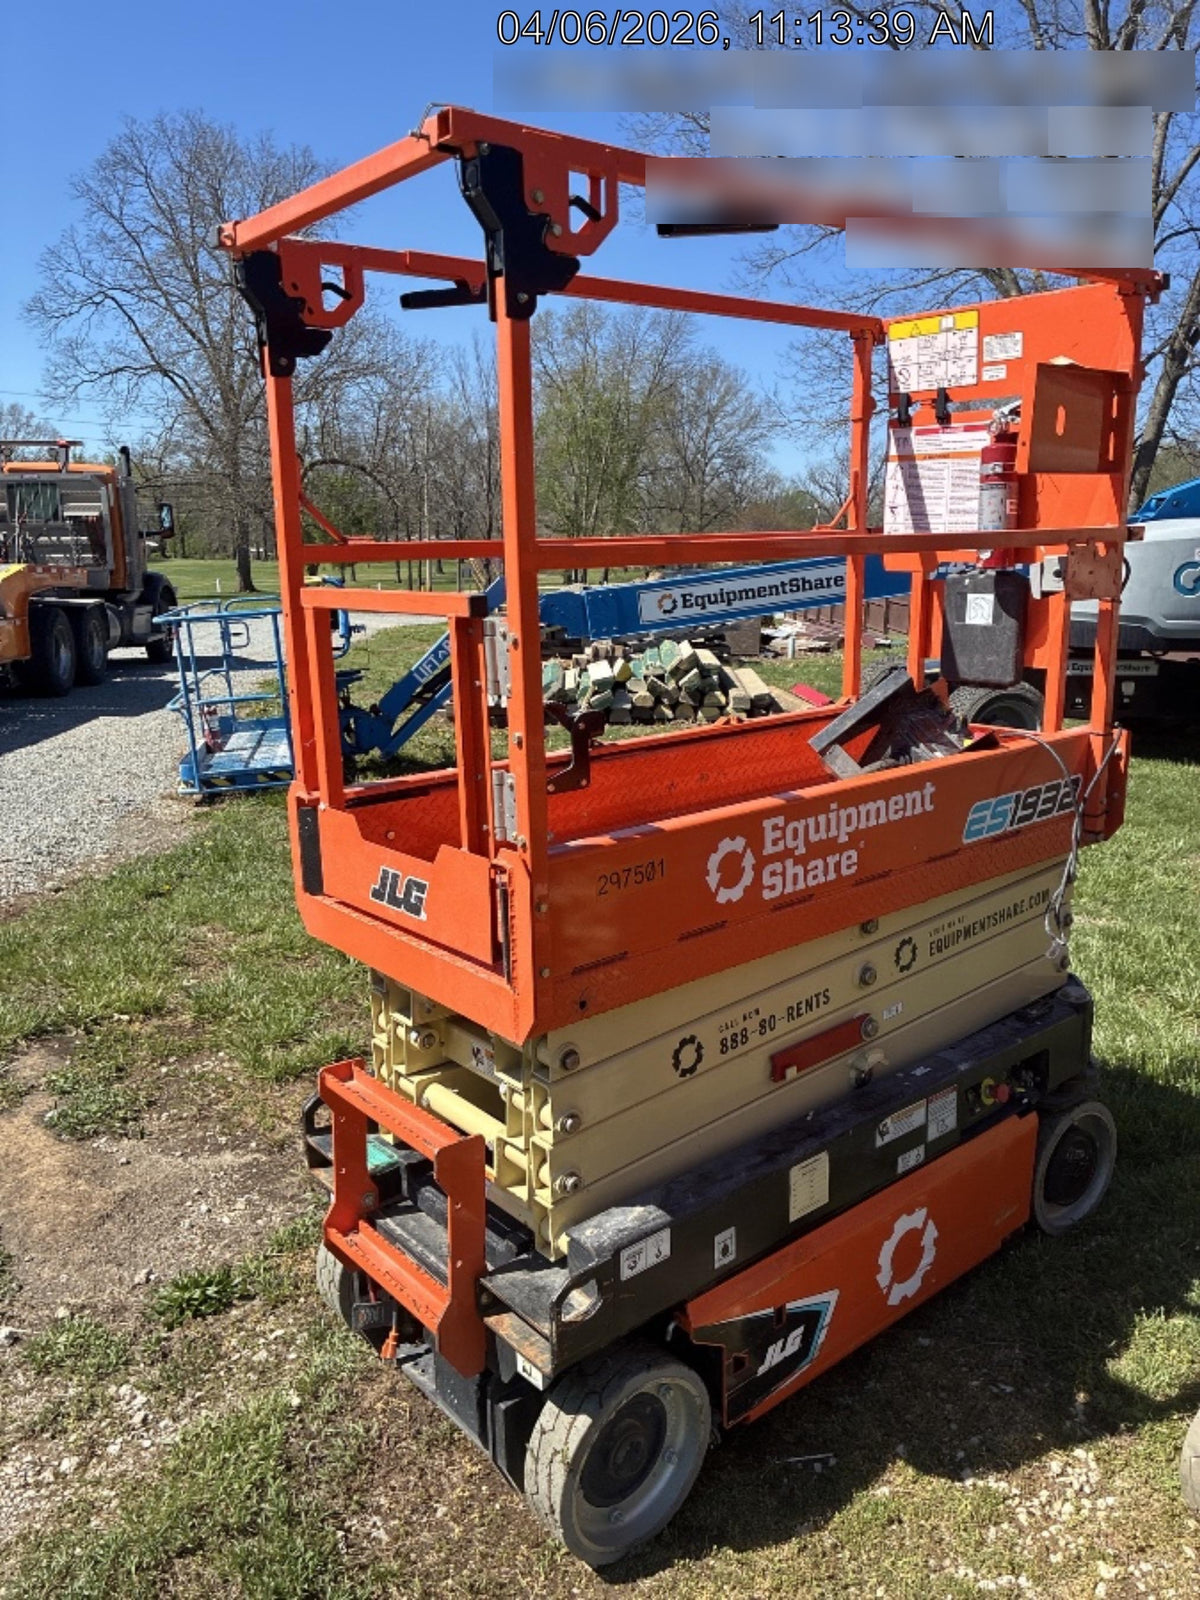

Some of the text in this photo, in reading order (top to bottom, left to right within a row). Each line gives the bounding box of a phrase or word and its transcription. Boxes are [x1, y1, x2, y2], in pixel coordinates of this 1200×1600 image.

[681, 575, 845, 611] EquipmentShare
[762, 781, 936, 856] Equipment
[963, 775, 1082, 842] ES1932
[370, 866, 429, 920] JLG
[597, 858, 665, 896] 297501
[761, 849, 858, 900] Share
[929, 888, 1050, 957] EQUIPMENTSHARE.COM
[719, 988, 831, 1055] 888-80-RENTS
[757, 1325, 805, 1376] JLG
